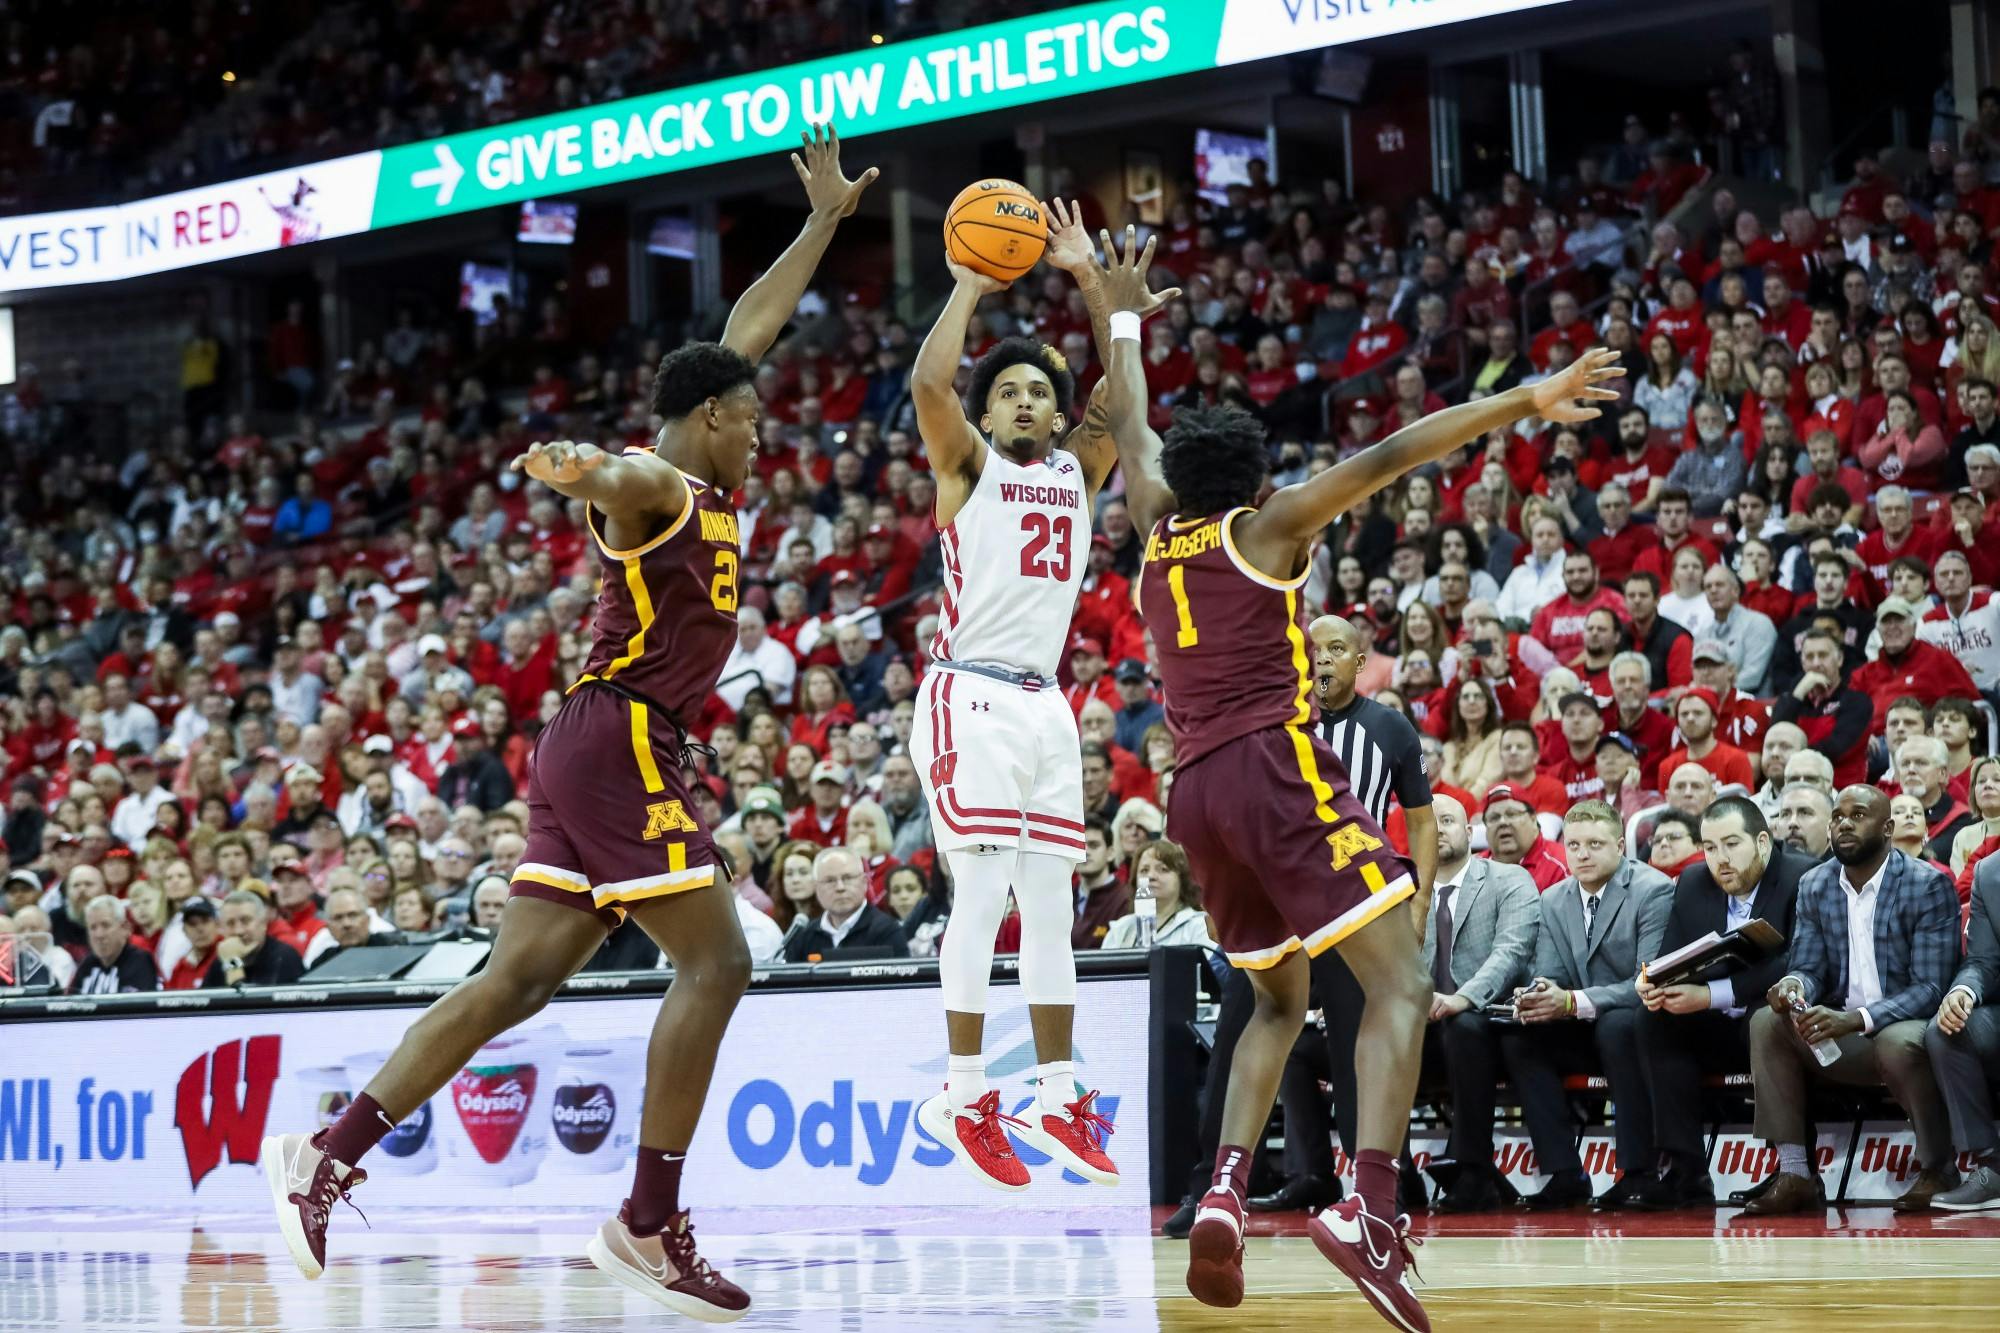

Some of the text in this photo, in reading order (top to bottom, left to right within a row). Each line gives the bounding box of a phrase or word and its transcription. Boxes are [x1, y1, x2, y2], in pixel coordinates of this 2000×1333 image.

[476, 5, 1171, 191] GIVE BACK TO UW ATHLETICS
[994, 200, 1040, 225] NCAA
[126, 216, 159, 258] IN
[1020, 511, 1072, 582] 23
[1167, 563, 1198, 649] 1
[929, 751, 958, 793] W
[642, 799, 699, 841] M
[1325, 822, 1384, 872] M
[77, 1077, 154, 1160] for
[459, 1092, 527, 1114] Odyssey
[554, 1104, 613, 1125] Odyssey
